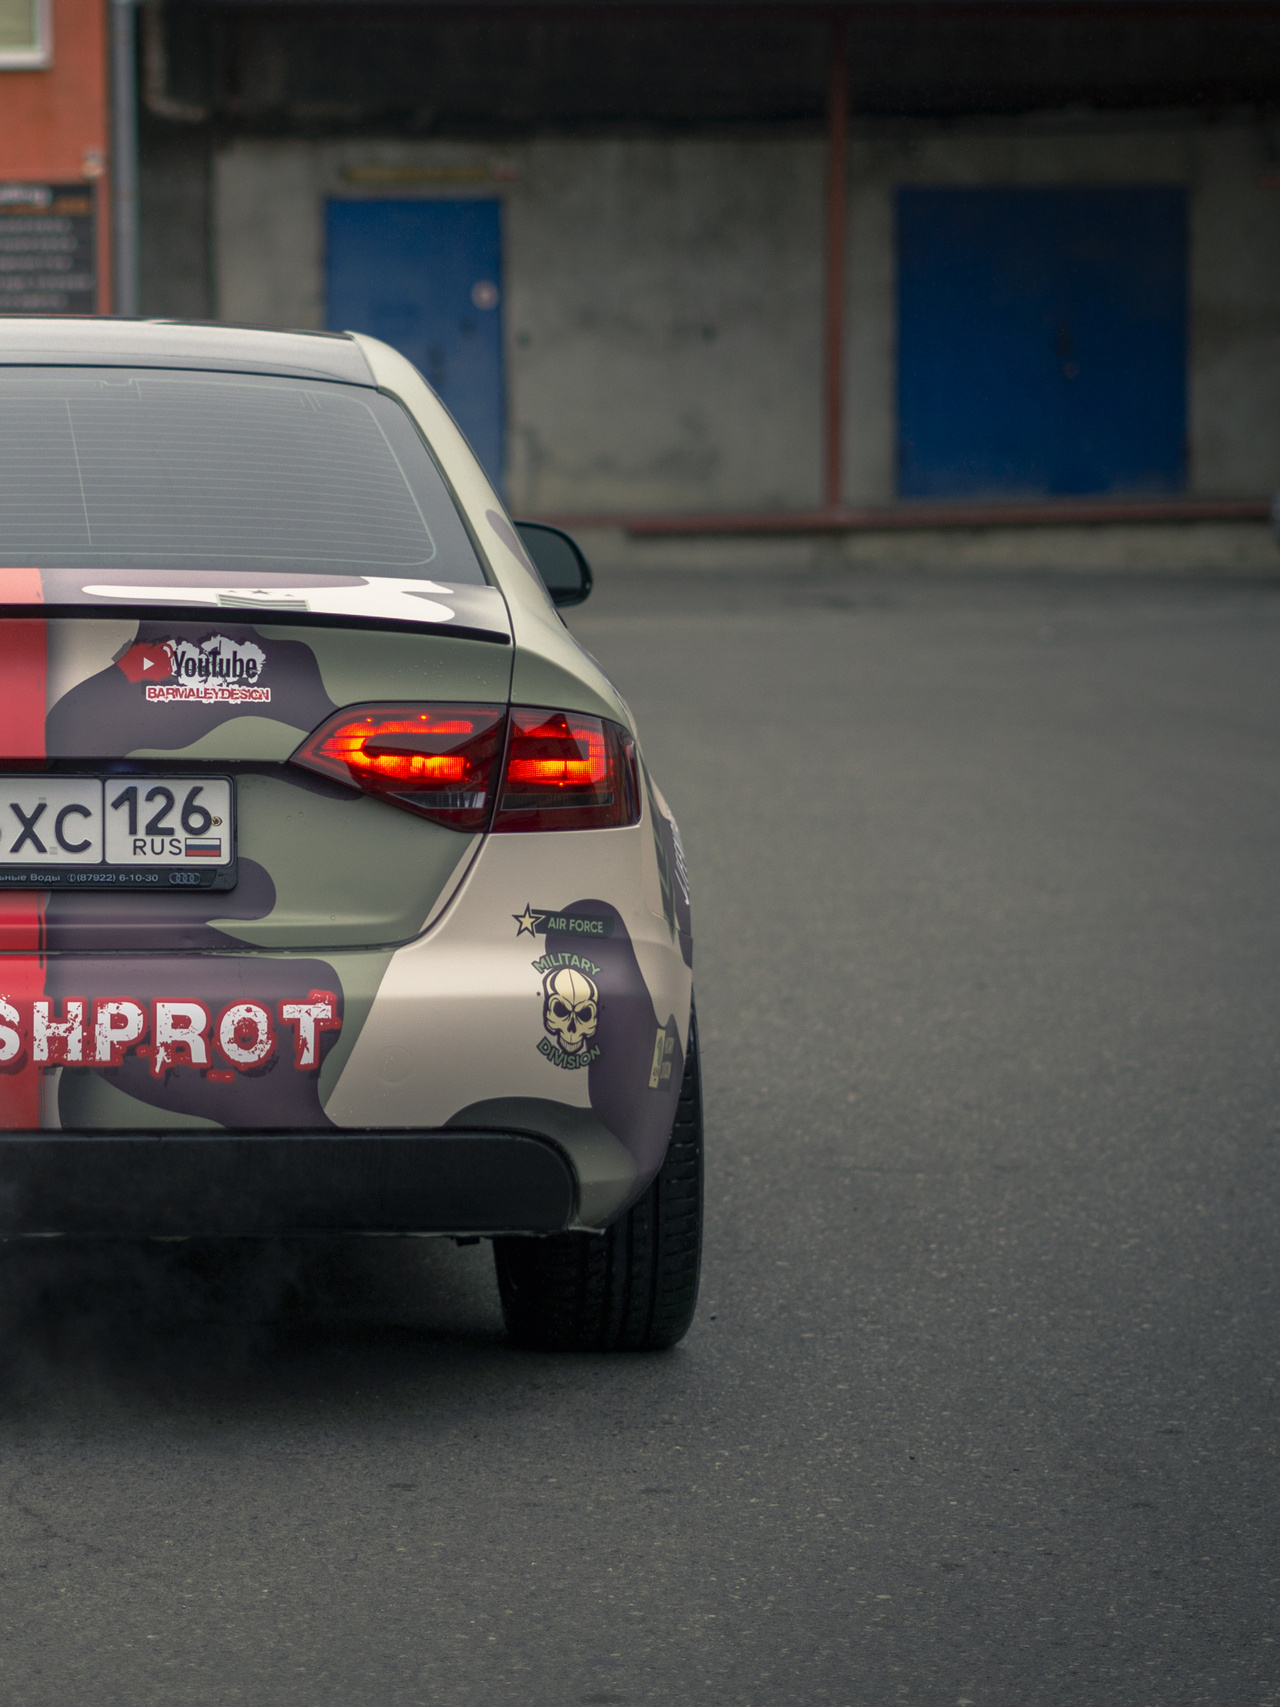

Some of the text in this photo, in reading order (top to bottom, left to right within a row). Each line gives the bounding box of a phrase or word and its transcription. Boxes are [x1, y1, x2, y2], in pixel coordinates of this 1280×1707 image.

[173, 647, 258, 679] YouTube
[147, 687, 270, 701] BARMALEYDESIGN
[110, 785, 213, 837] 126
[132, 838, 183, 857] RUS
[30, 872, 62, 882] Воды
[119, 873, 159, 883] 6-10-30
[547, 917, 604, 933] AIR FORCE
[532, 952, 601, 975] MILITARY
[537, 1036, 601, 1070] DIVISION
